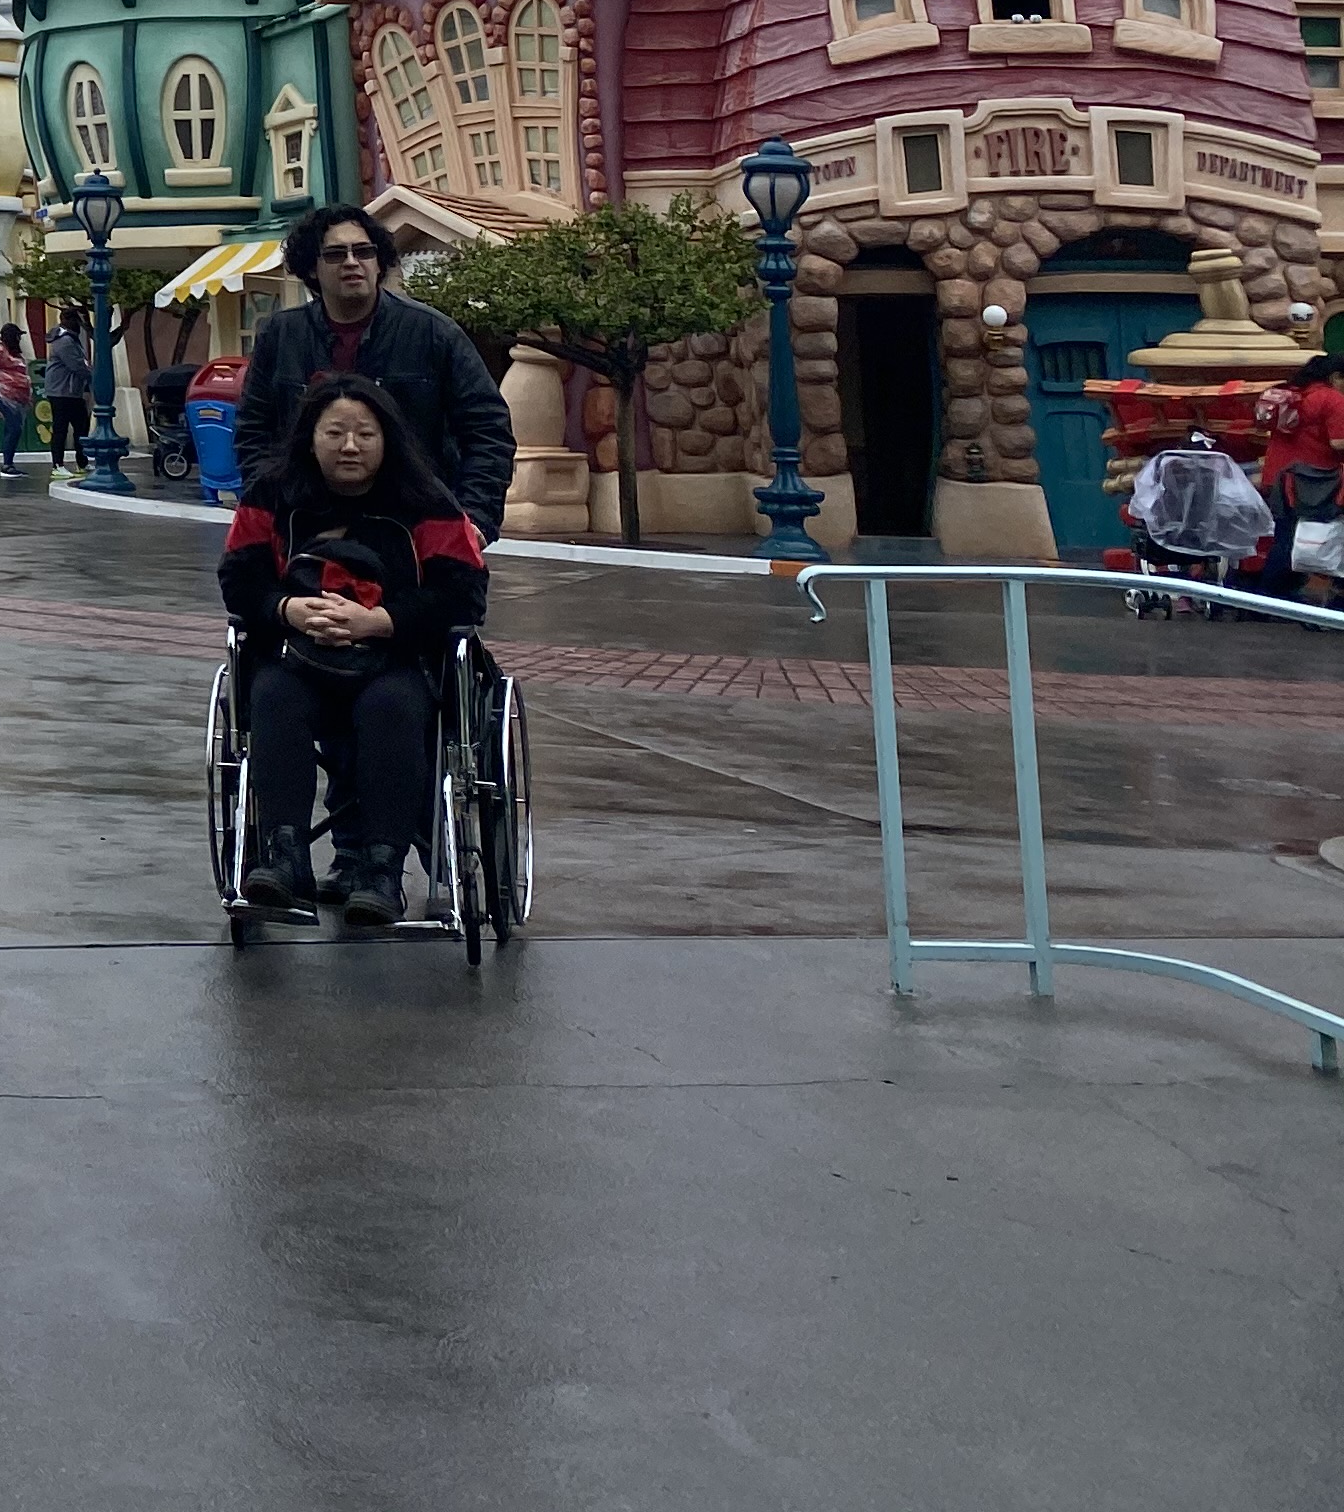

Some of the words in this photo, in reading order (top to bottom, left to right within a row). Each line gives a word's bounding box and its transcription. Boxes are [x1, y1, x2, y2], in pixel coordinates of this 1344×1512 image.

[813, 156, 856, 185] TOWN
[984, 127, 1070, 177] FIRE
[1197, 151, 1308, 199] DEPARTMENT
